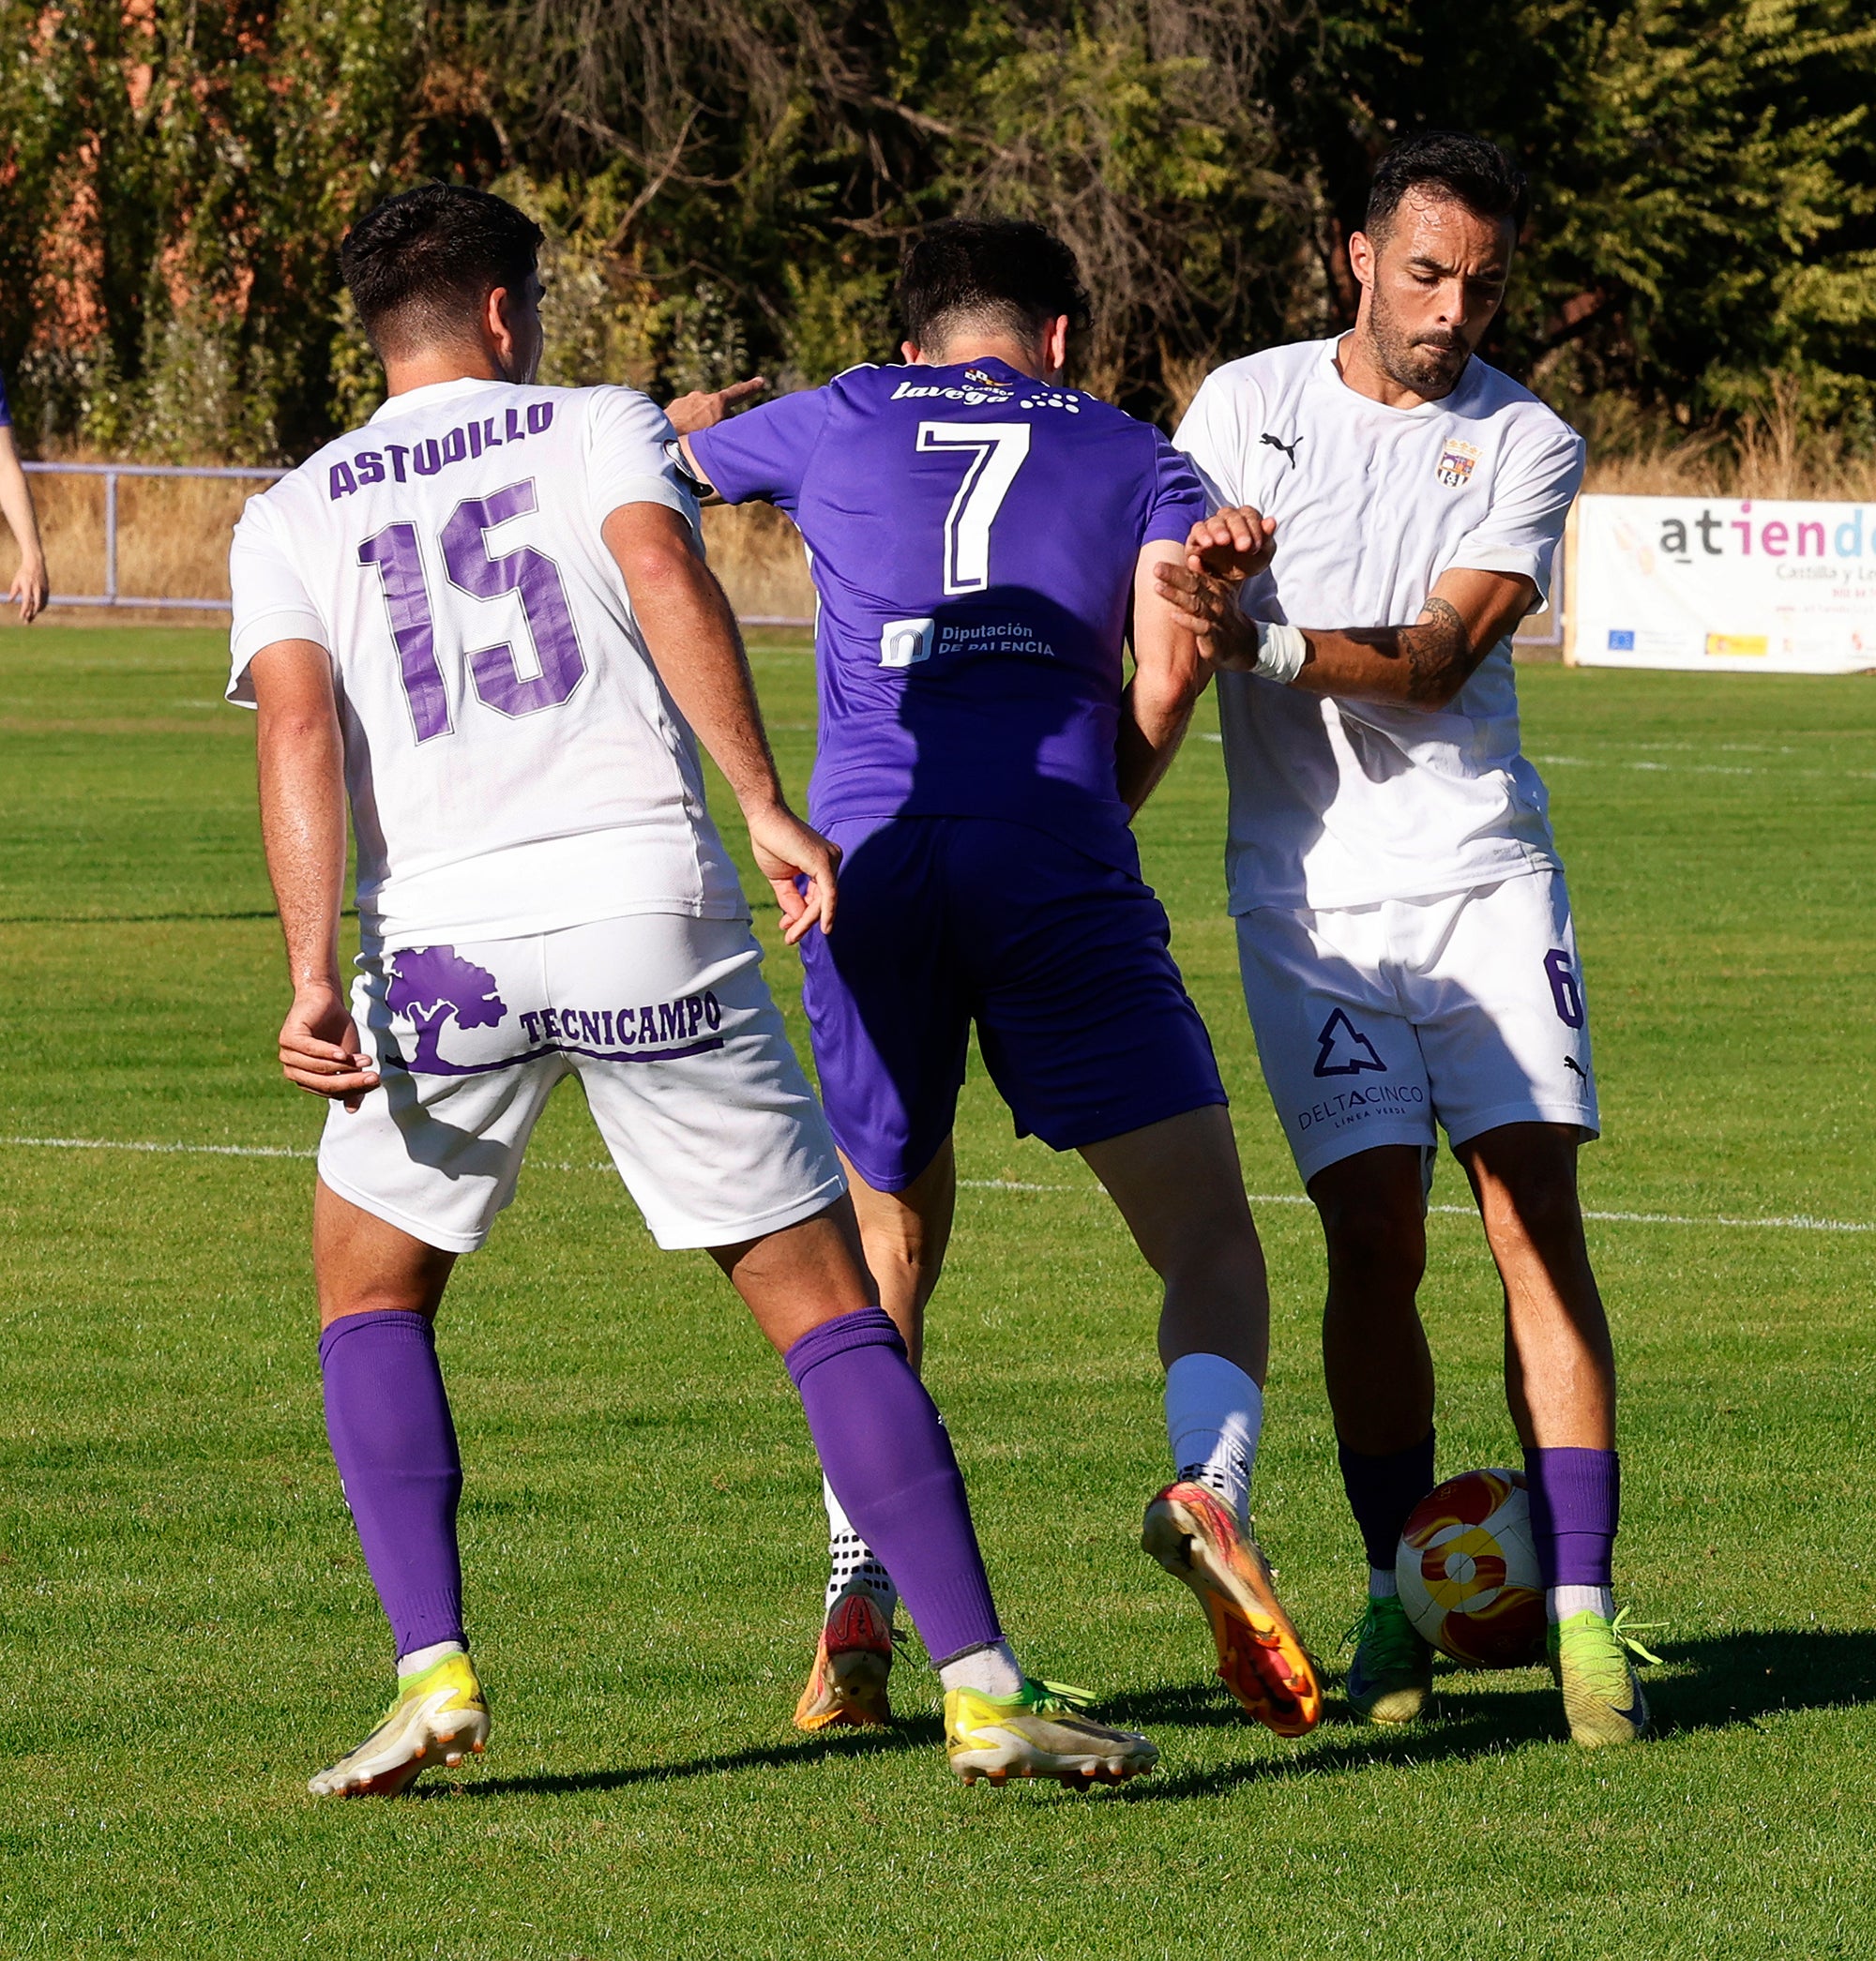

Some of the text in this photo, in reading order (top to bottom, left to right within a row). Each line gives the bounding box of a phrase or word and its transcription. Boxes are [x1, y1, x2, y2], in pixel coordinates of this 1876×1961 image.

[890, 381, 1010, 405] lavega
[330, 401, 553, 501] ASTUDILLO
[915, 421, 1031, 596] 7
[1659, 501, 1876, 557] atiend
[357, 476, 588, 747] 15
[942, 623, 1032, 642] Diputación
[938, 643, 962, 655] DE
[1543, 948, 1584, 1031] 6
[520, 990, 721, 1046] TECNICAMPO
[1298, 1086, 1423, 1130] DELTACINCO
